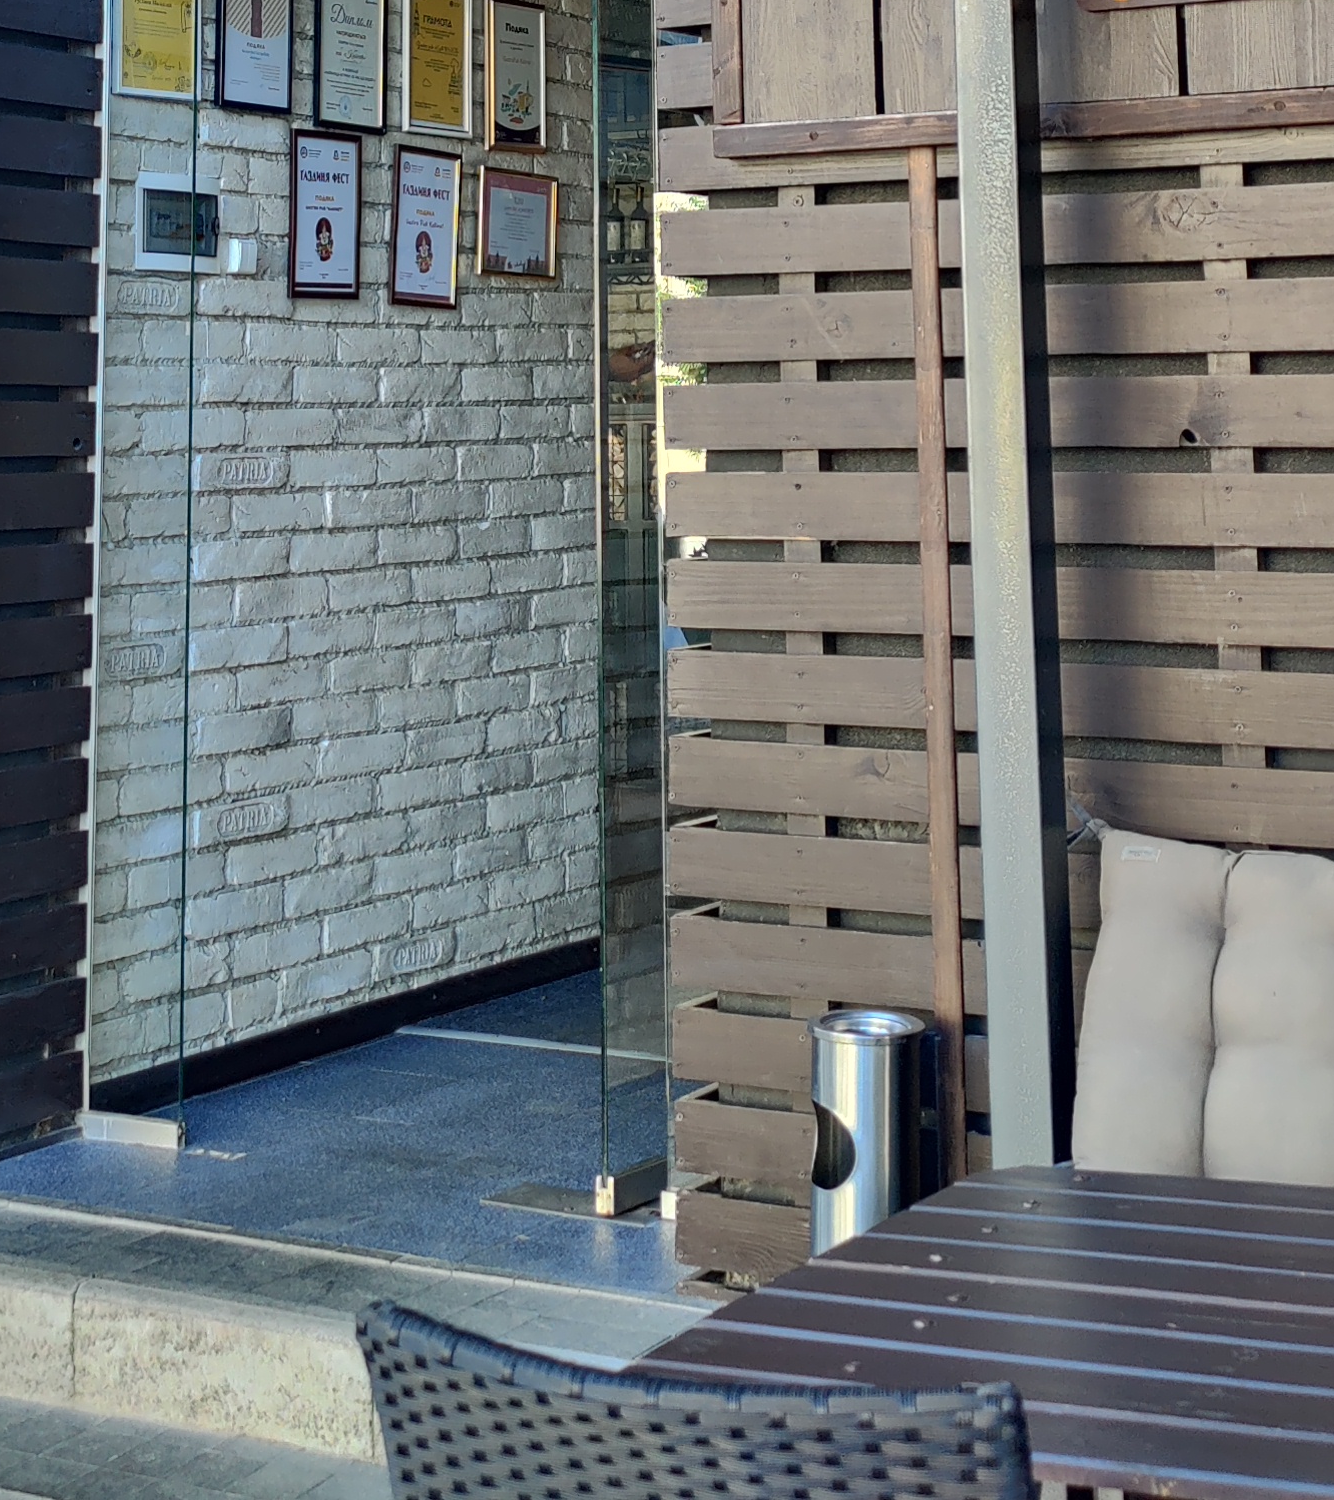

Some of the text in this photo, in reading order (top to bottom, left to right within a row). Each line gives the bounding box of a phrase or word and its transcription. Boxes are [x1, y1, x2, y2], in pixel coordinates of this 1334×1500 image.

[423, 14, 452, 28] ГРАМОТА
[332, 172, 350, 184] ФЕСТ
[433, 187, 450, 201] ФЕСТ
[123, 284, 172, 306] PATRIA
[222, 461, 267, 481] PATRIA
[110, 648, 159, 673] PATRIA
[222, 806, 267, 832] PATRIA
[396, 941, 437, 967] PATRIA
